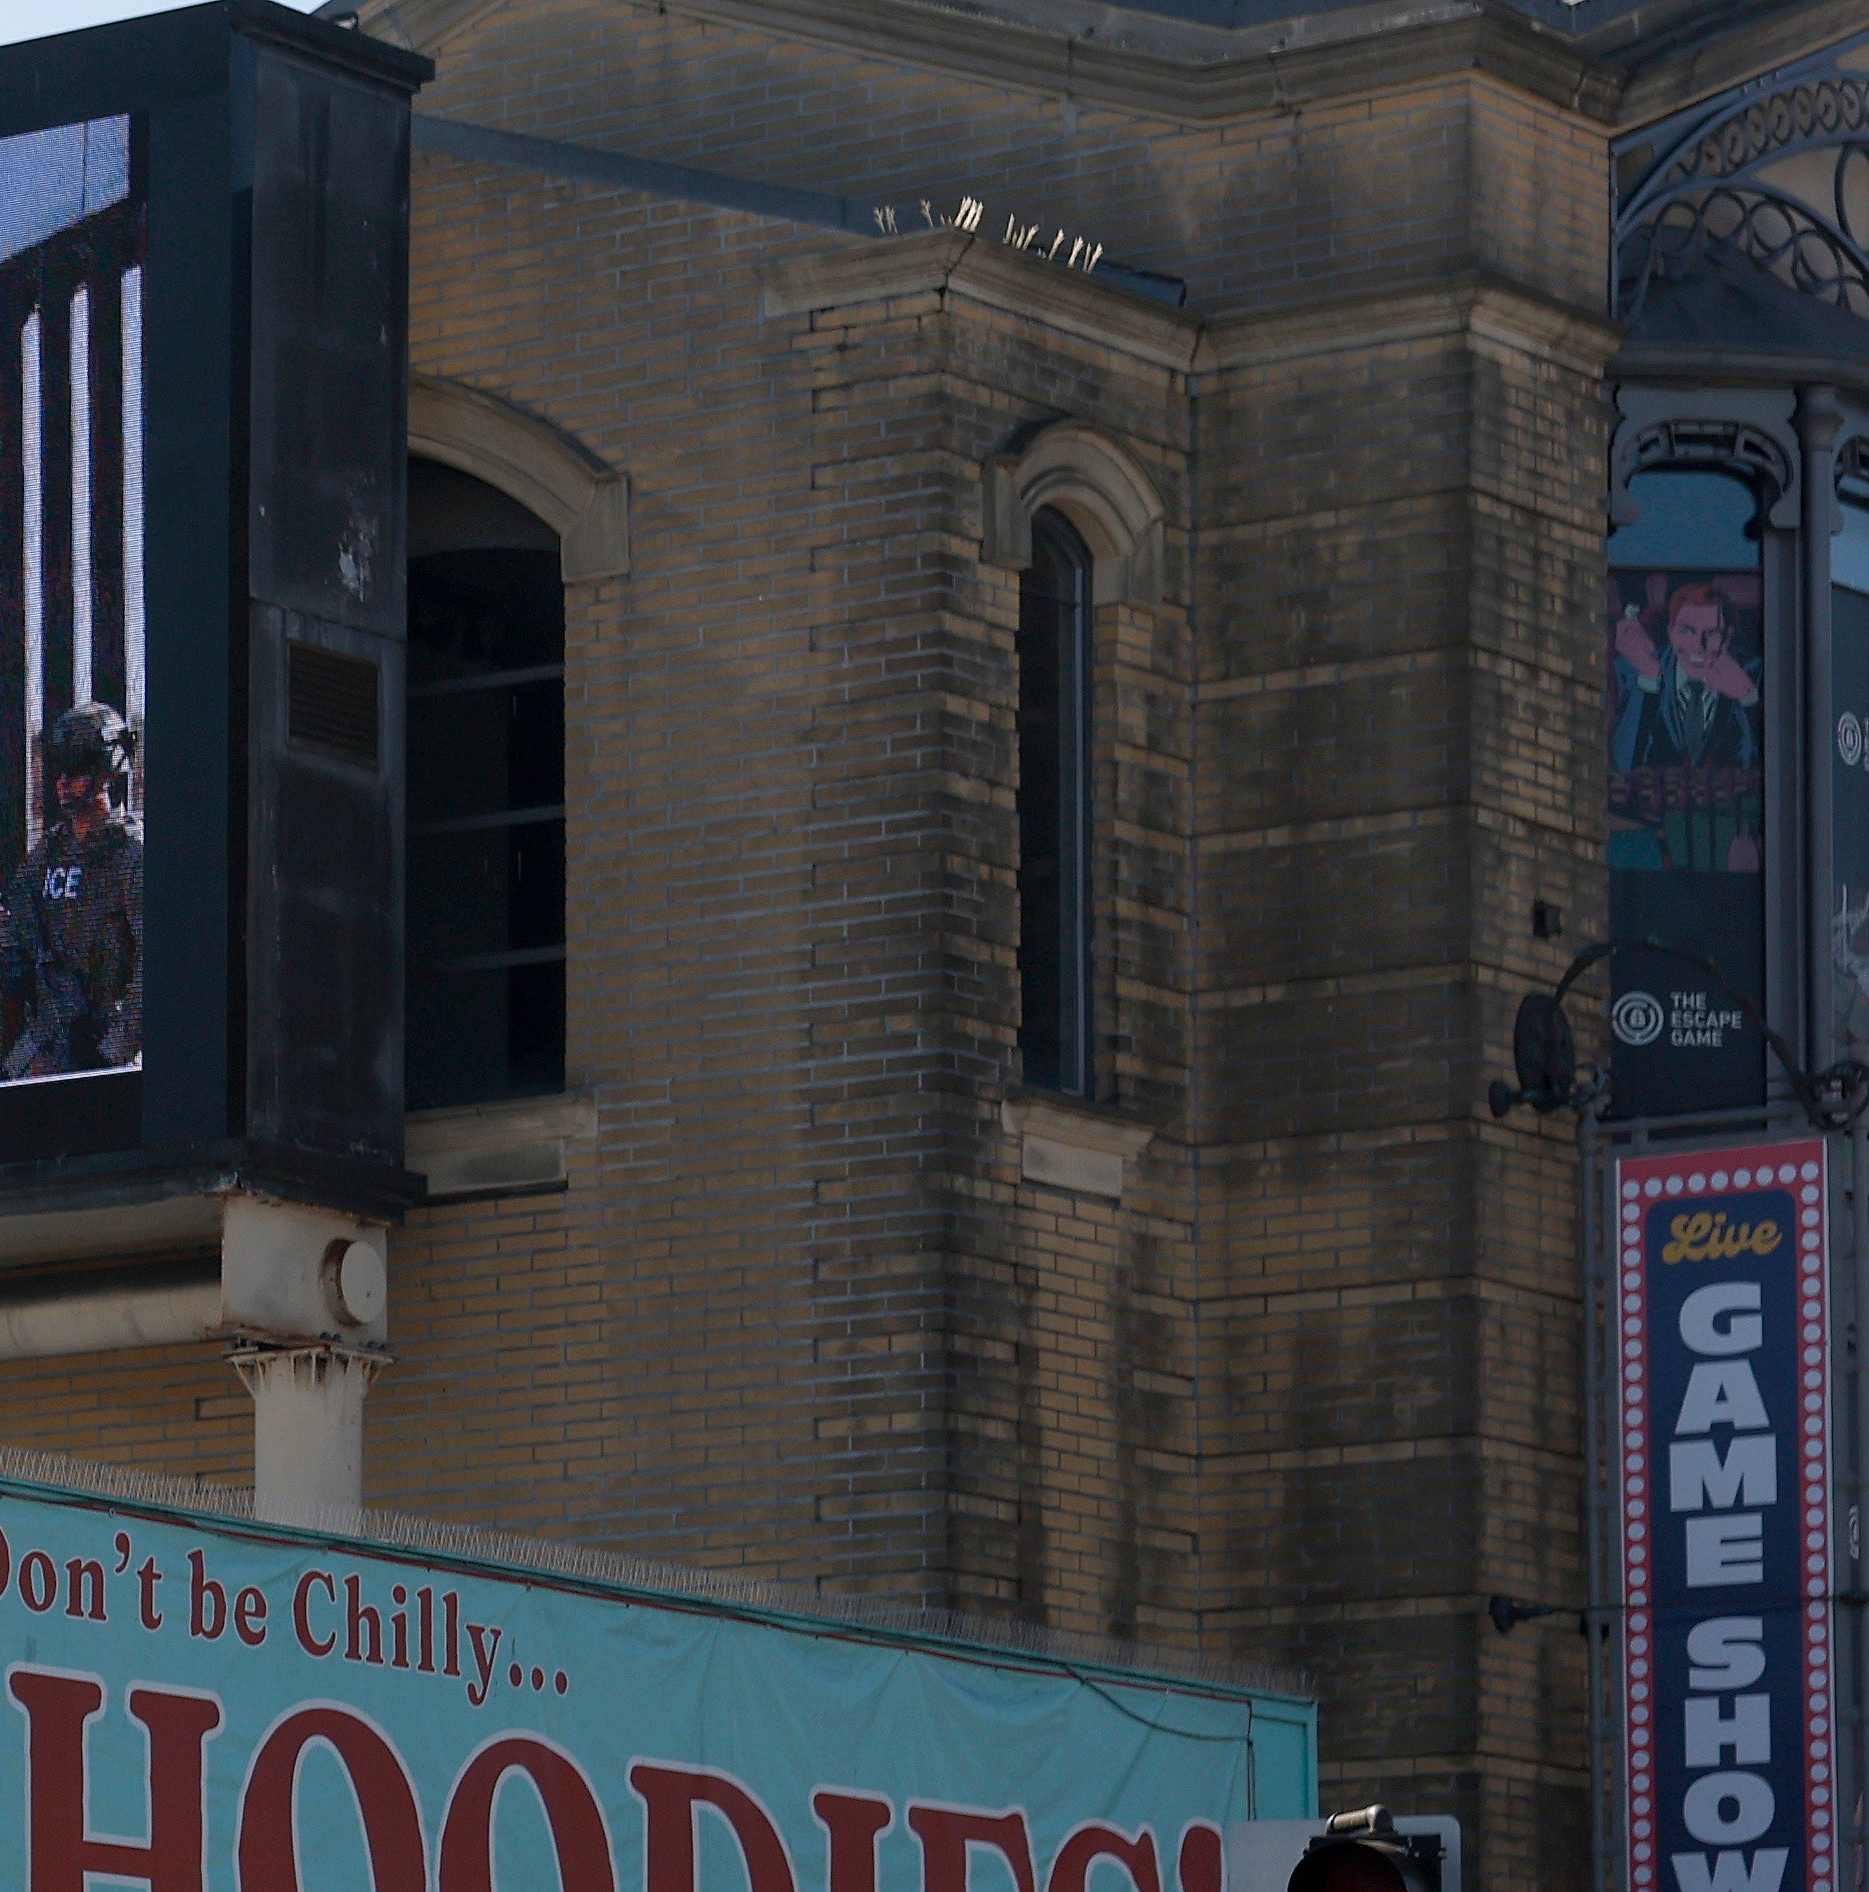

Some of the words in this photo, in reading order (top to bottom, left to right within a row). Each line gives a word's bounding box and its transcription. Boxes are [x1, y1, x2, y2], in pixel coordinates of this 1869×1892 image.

[42, 864, 83, 900] ICE
[1670, 991, 1707, 1010] THE
[1671, 1010, 1743, 1030] ESCAPE
[1671, 1029, 1723, 1047] GAME
[1662, 1211, 1782, 1262] Live
[1669, 1281, 1778, 1590] GAME
[187, 1548, 267, 1648] be
[291, 1570, 569, 1708] Chilly...
